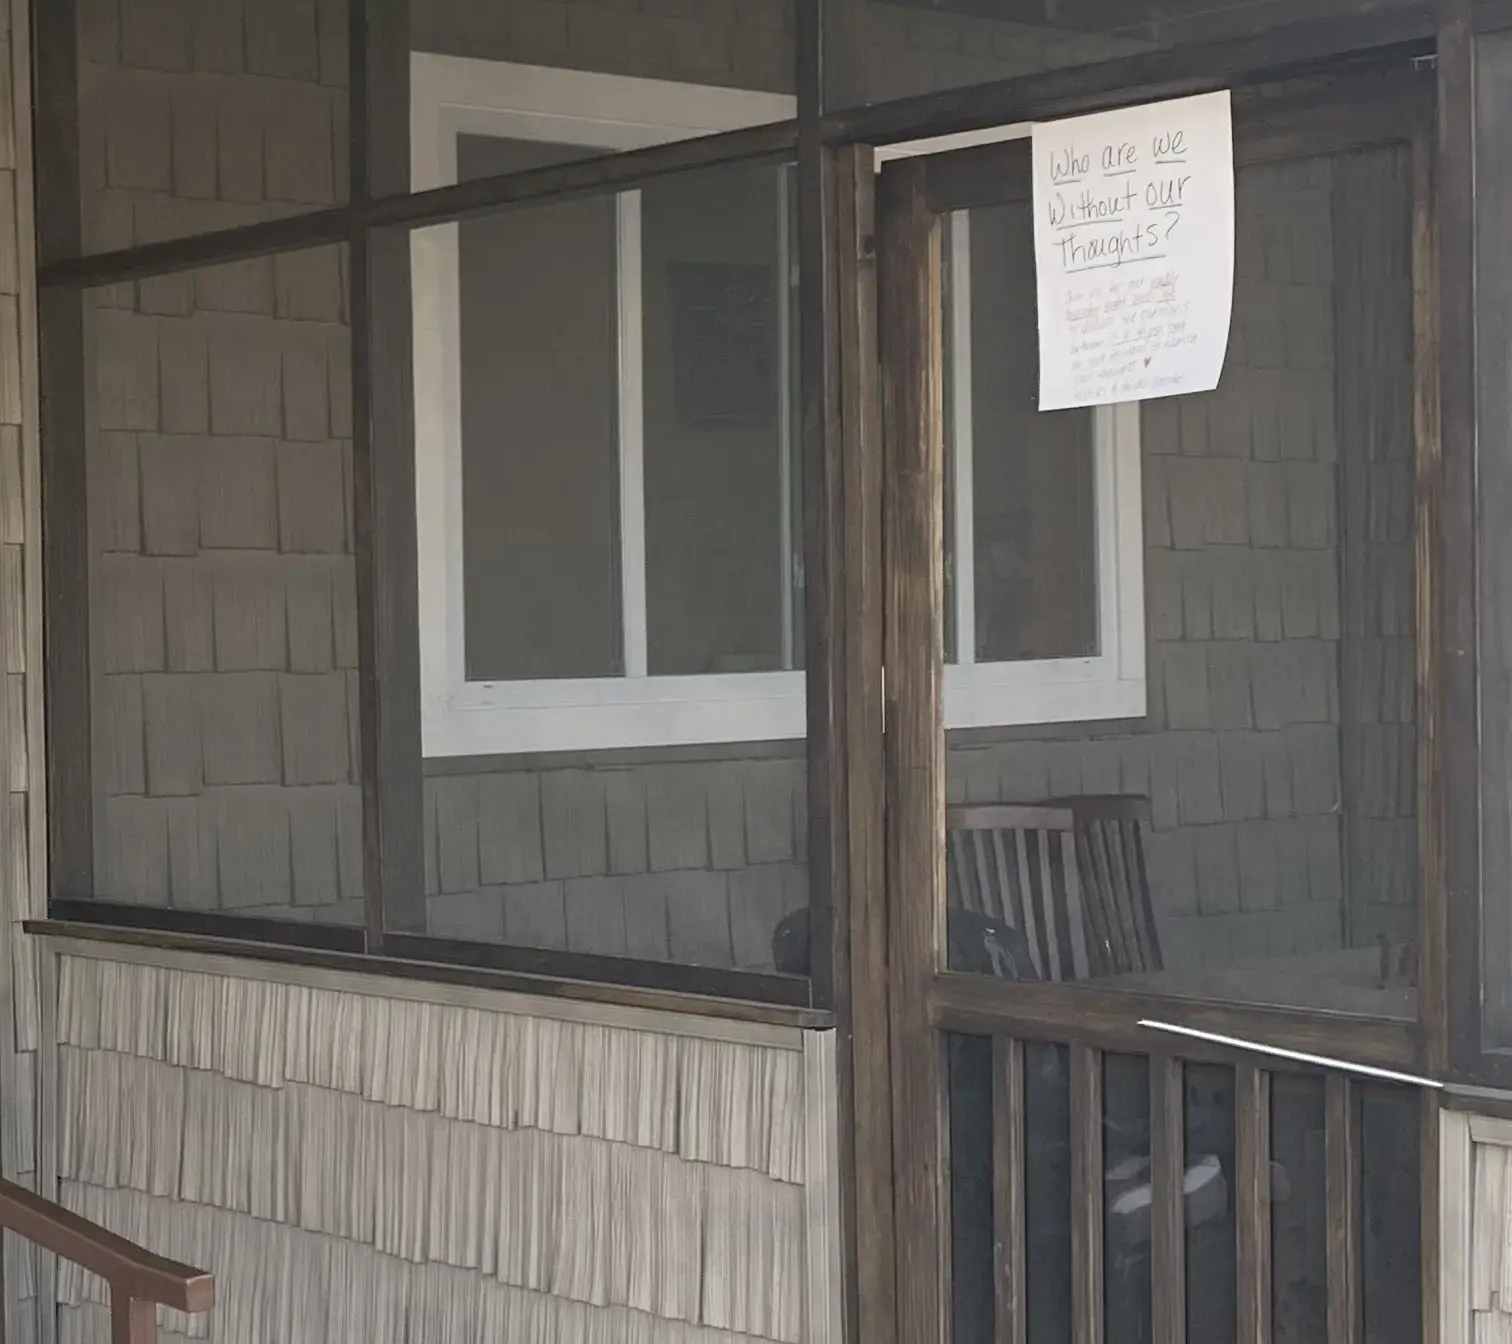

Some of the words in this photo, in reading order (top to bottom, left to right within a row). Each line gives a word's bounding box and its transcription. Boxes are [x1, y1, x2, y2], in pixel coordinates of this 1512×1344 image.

[1050, 140, 1090, 182] Who
[1101, 142, 1140, 171] are
[1152, 130, 1189, 158] we
[1048, 180, 1139, 226] Without
[1145, 175, 1192, 207] our
